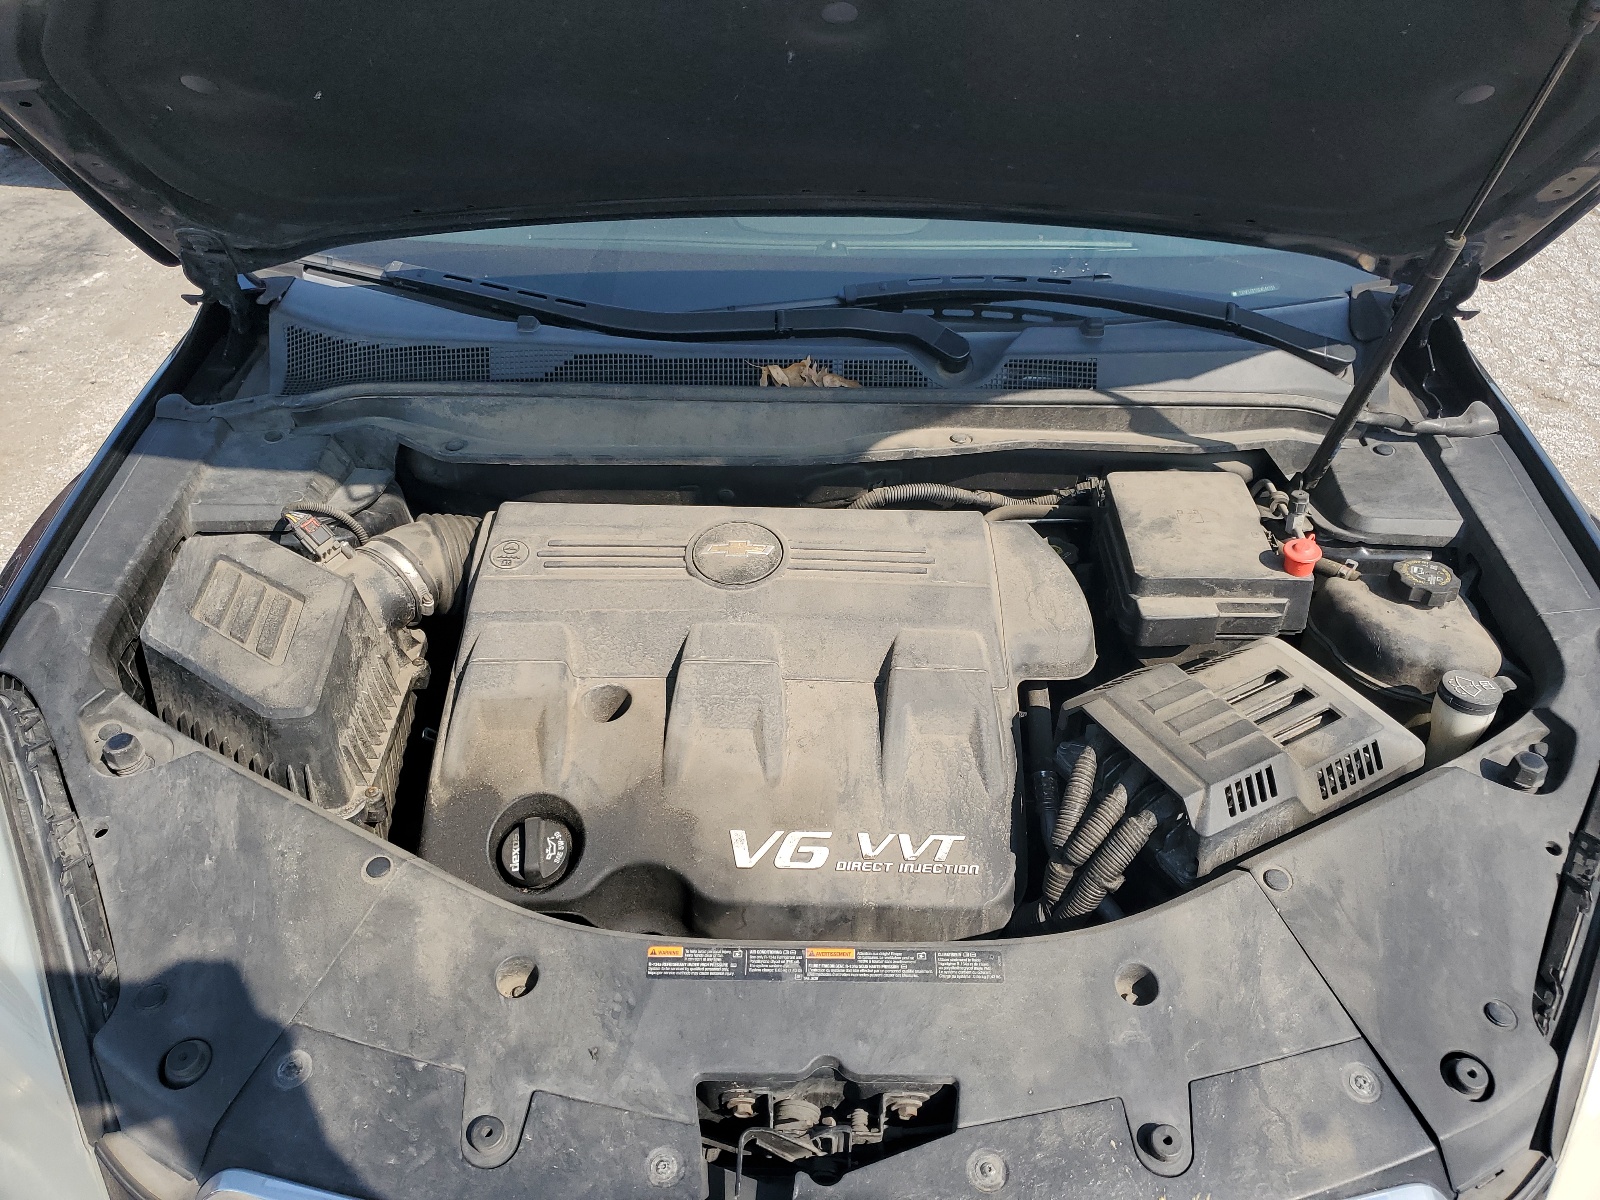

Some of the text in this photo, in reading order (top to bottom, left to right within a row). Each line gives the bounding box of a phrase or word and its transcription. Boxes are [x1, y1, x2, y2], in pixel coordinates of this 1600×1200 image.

[509, 833, 520, 872] dexos
[729, 829, 832, 869] V6
[857, 832, 966, 862] VVT
[835, 861, 980, 875] DIRECT INJECTION
